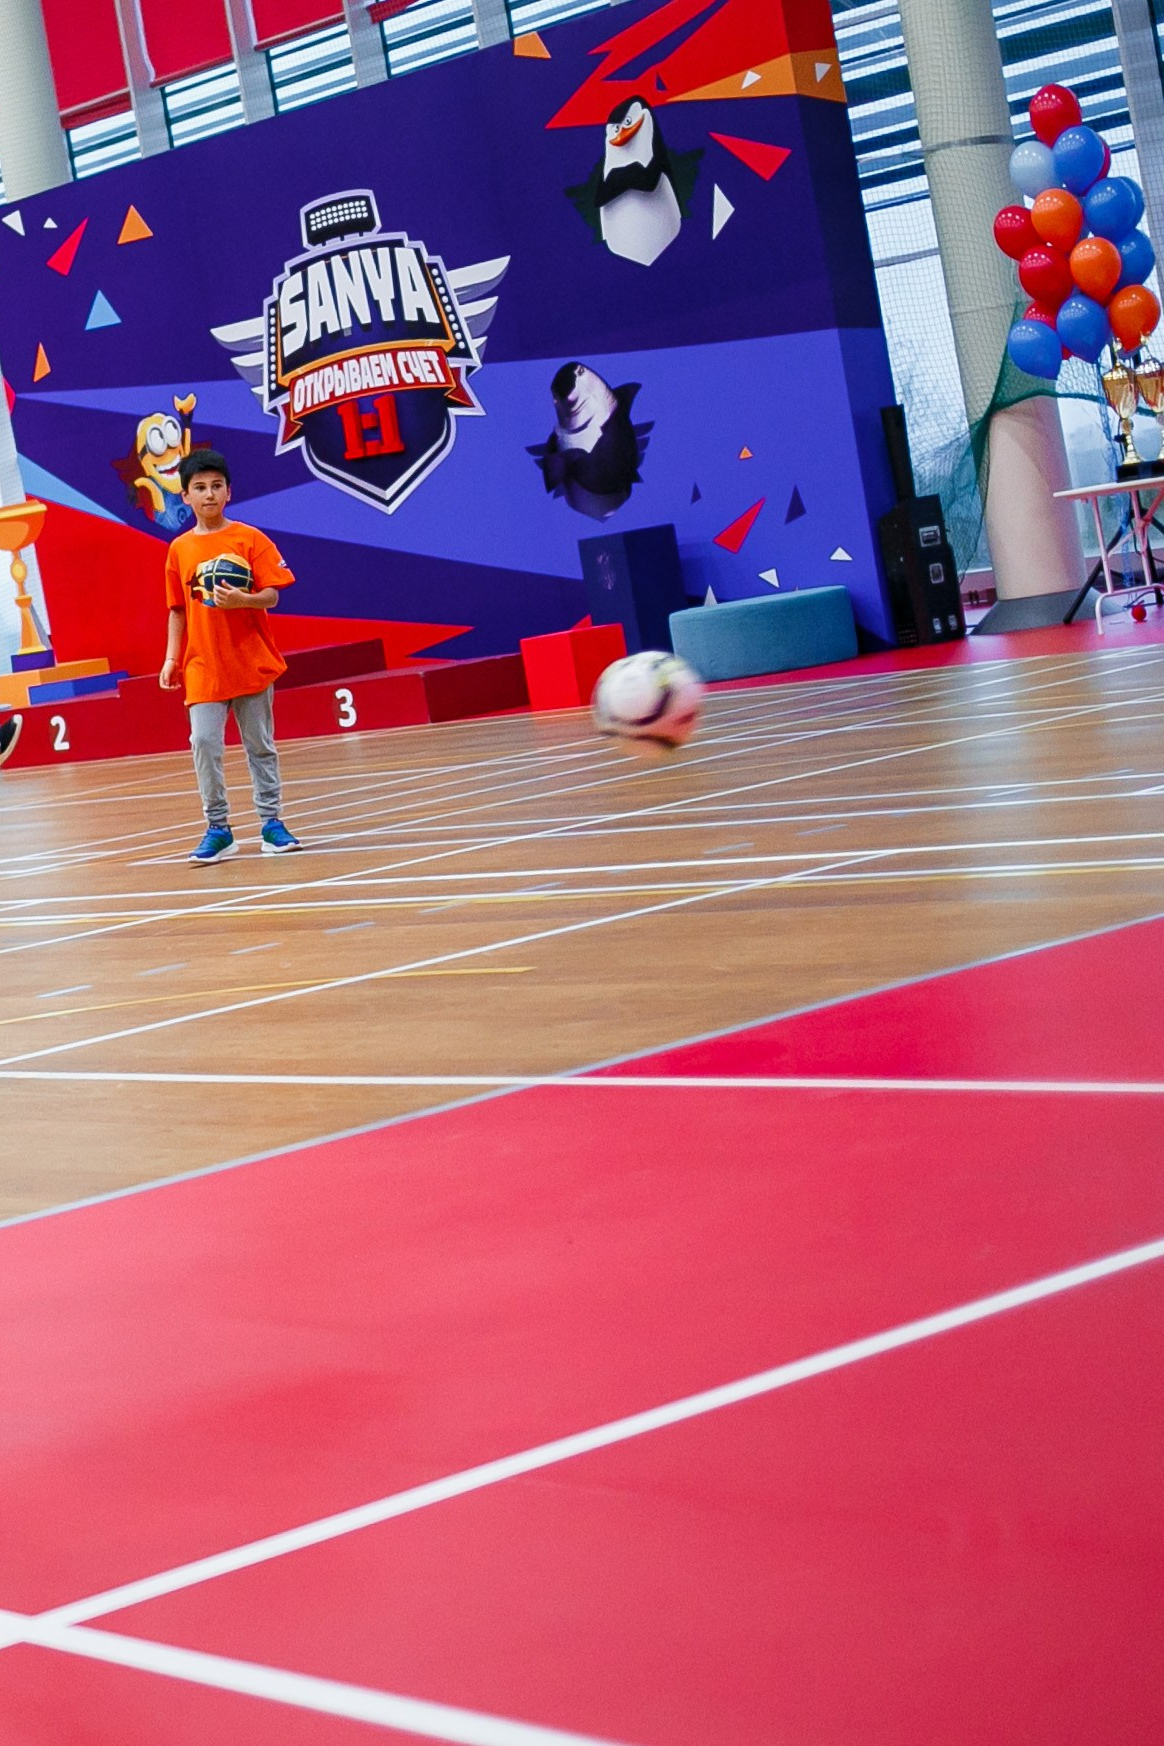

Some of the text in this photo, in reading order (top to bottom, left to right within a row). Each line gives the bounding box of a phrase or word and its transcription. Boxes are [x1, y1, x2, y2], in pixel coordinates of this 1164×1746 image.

[280, 247, 440, 357] SANYA
[293, 350, 446, 413] ОТКРЫВАЕМ СЧЕТ
[50, 715, 71, 751] 2
[334, 688, 357, 728] 3
